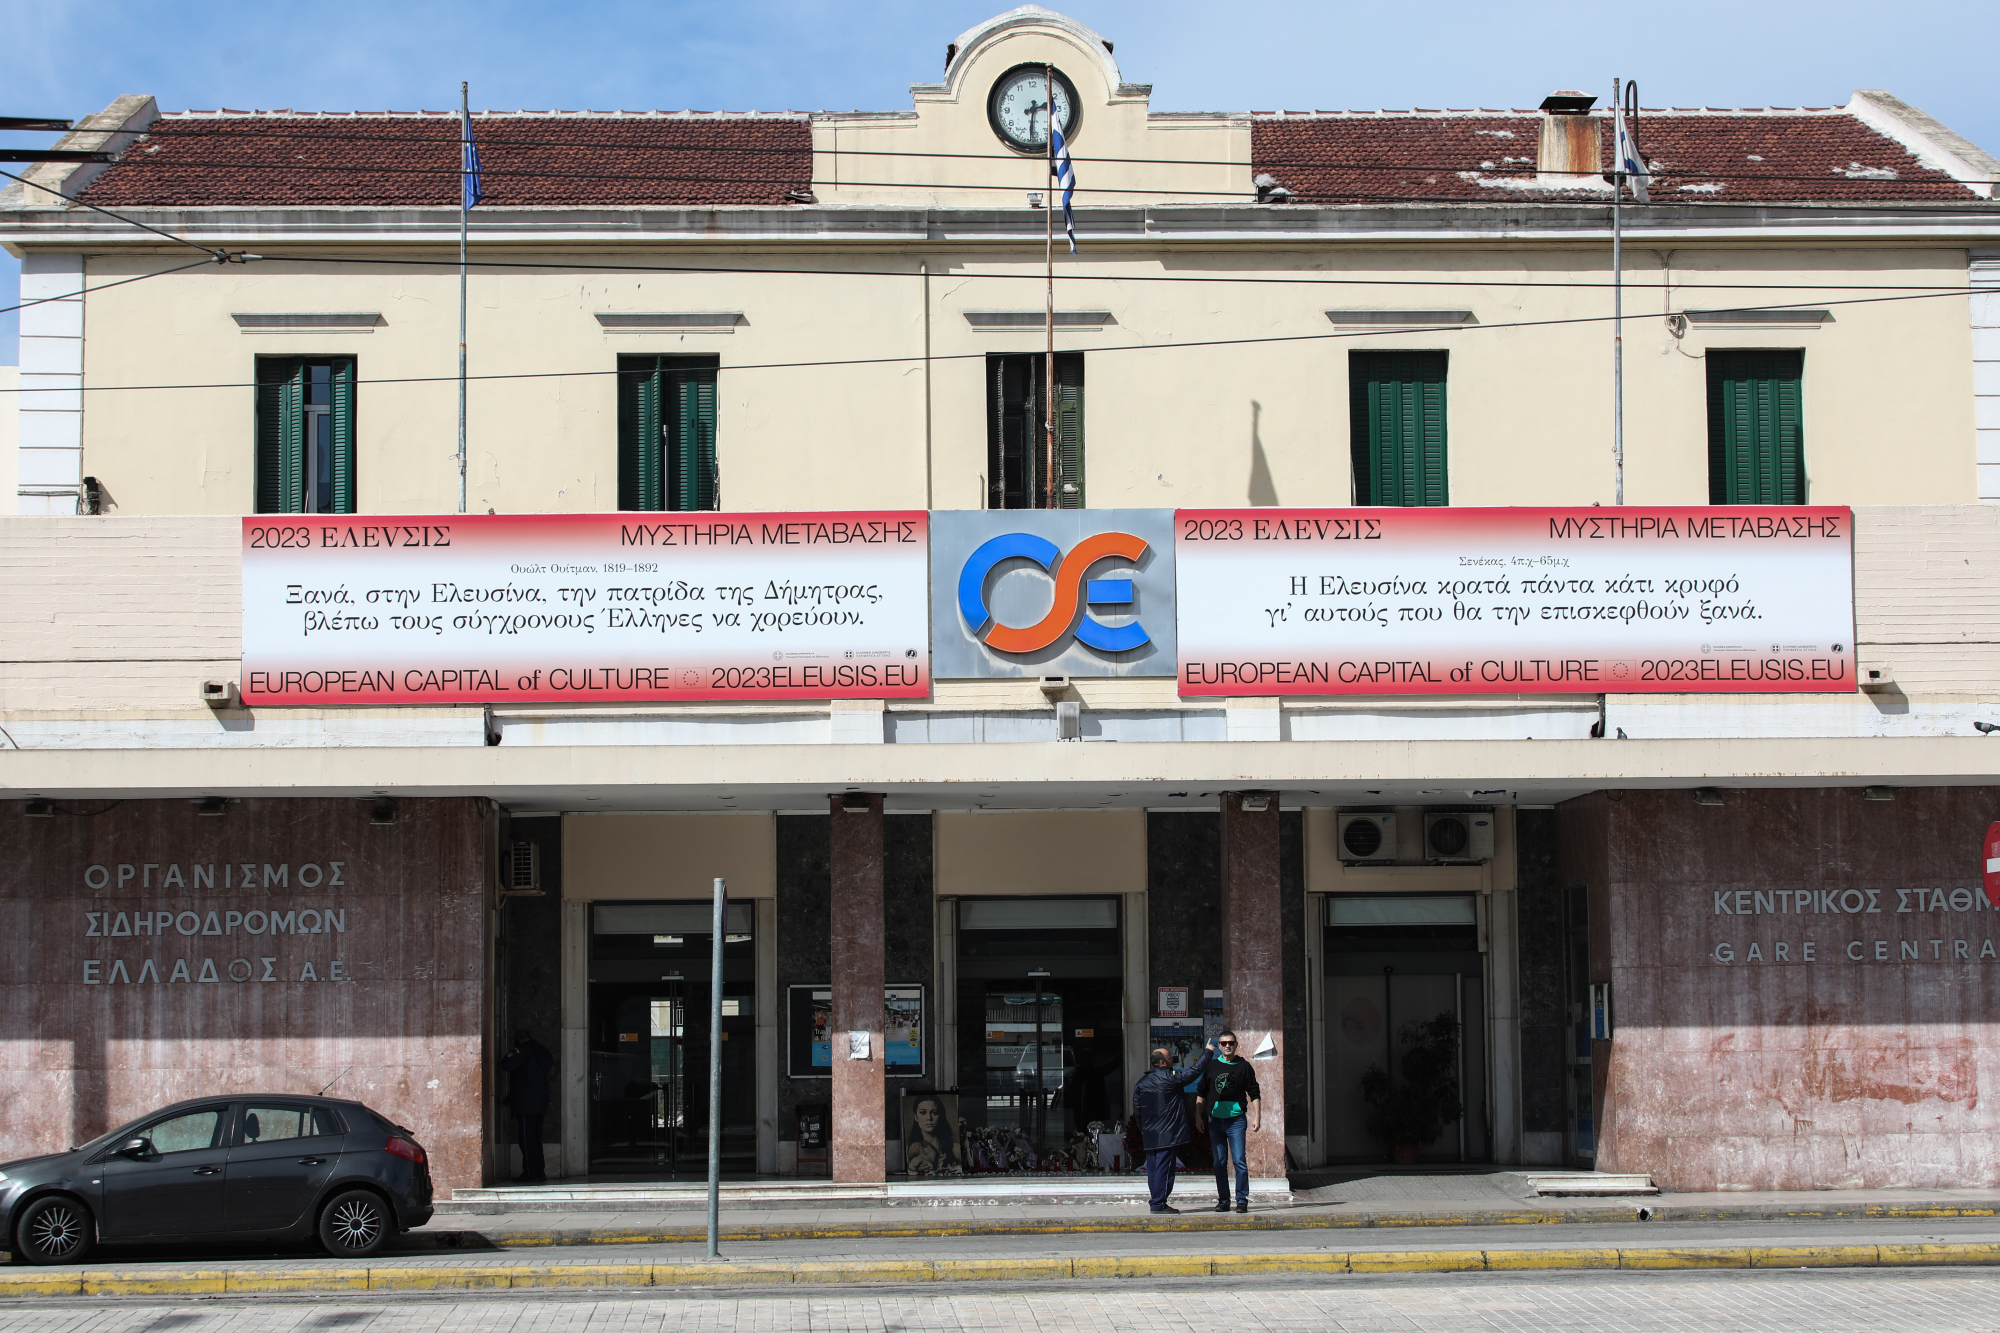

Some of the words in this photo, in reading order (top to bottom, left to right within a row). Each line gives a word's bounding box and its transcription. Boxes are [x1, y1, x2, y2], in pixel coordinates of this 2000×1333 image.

[251, 527, 310, 548] 2023
[622, 524, 753, 545] ΜΥΣΤΗΡΙΑ
[763, 522, 916, 544] ΜΕΤΑΒΑΣΗΣ
[1185, 520, 1243, 540] 2023
[1550, 518, 1679, 538] ΜΥΣΤΗΡΙΑ
[1688, 517, 1840, 538] ΜΕΤΑΒΑΣΗΣ
[286, 584, 355, 605] Ξανά,
[366, 590, 420, 609] στην
[431, 582, 546, 604] Ελευσίνα,
[557, 588, 596, 607] την
[607, 581, 705, 607] πατρίδα
[715, 587, 753, 606] της
[764, 580, 882, 607] Δήμητρας,
[1290, 577, 1307, 595] Η
[1319, 575, 1427, 595] Ελευσίνα
[1438, 574, 1510, 600] κρατά
[1521, 574, 1594, 593] πάντα
[1605, 574, 1654, 593] κάτι
[1665, 574, 1739, 601] κρυφό
[304, 609, 379, 635] βλέπω
[389, 616, 442, 635] τους
[453, 609, 594, 634] σύγχρονους
[712, 613, 740, 626] να
[751, 608, 864, 633] χορεύουν.
[1304, 602, 1388, 627] αυτούς
[1398, 608, 1442, 621] που
[1454, 599, 1482, 620] θα
[1492, 607, 1530, 626] την
[1700, 599, 1762, 625] ξανά.
[250, 671, 394, 693] EUROPEAN
[404, 670, 509, 691] CAPITAL
[518, 669, 541, 690] of
[549, 668, 669, 690] CULTURE
[712, 665, 918, 688] 2023ELEUSIS.EU
[1186, 662, 1328, 684] EUROPEAN
[1338, 661, 1442, 683] CAPITAL
[1450, 661, 1473, 682] of
[1481, 660, 1599, 682] CULTURE
[1641, 659, 1844, 680] 2023ELEUSIS.EU
[84, 861, 345, 889] ΟΡΓΑΝΙΣΜΟΣ
[1714, 889, 1881, 915] ΚΕΝΤΡΙΚΟΣ
[85, 908, 345, 937] ΣΙΔΗΡΟΔΡΟΜΩΝ
[1714, 941, 1816, 962] GARE
[83, 957, 278, 984] ΕΛΛΑΔΟΣ
[299, 960, 353, 982] Α.Ε.
